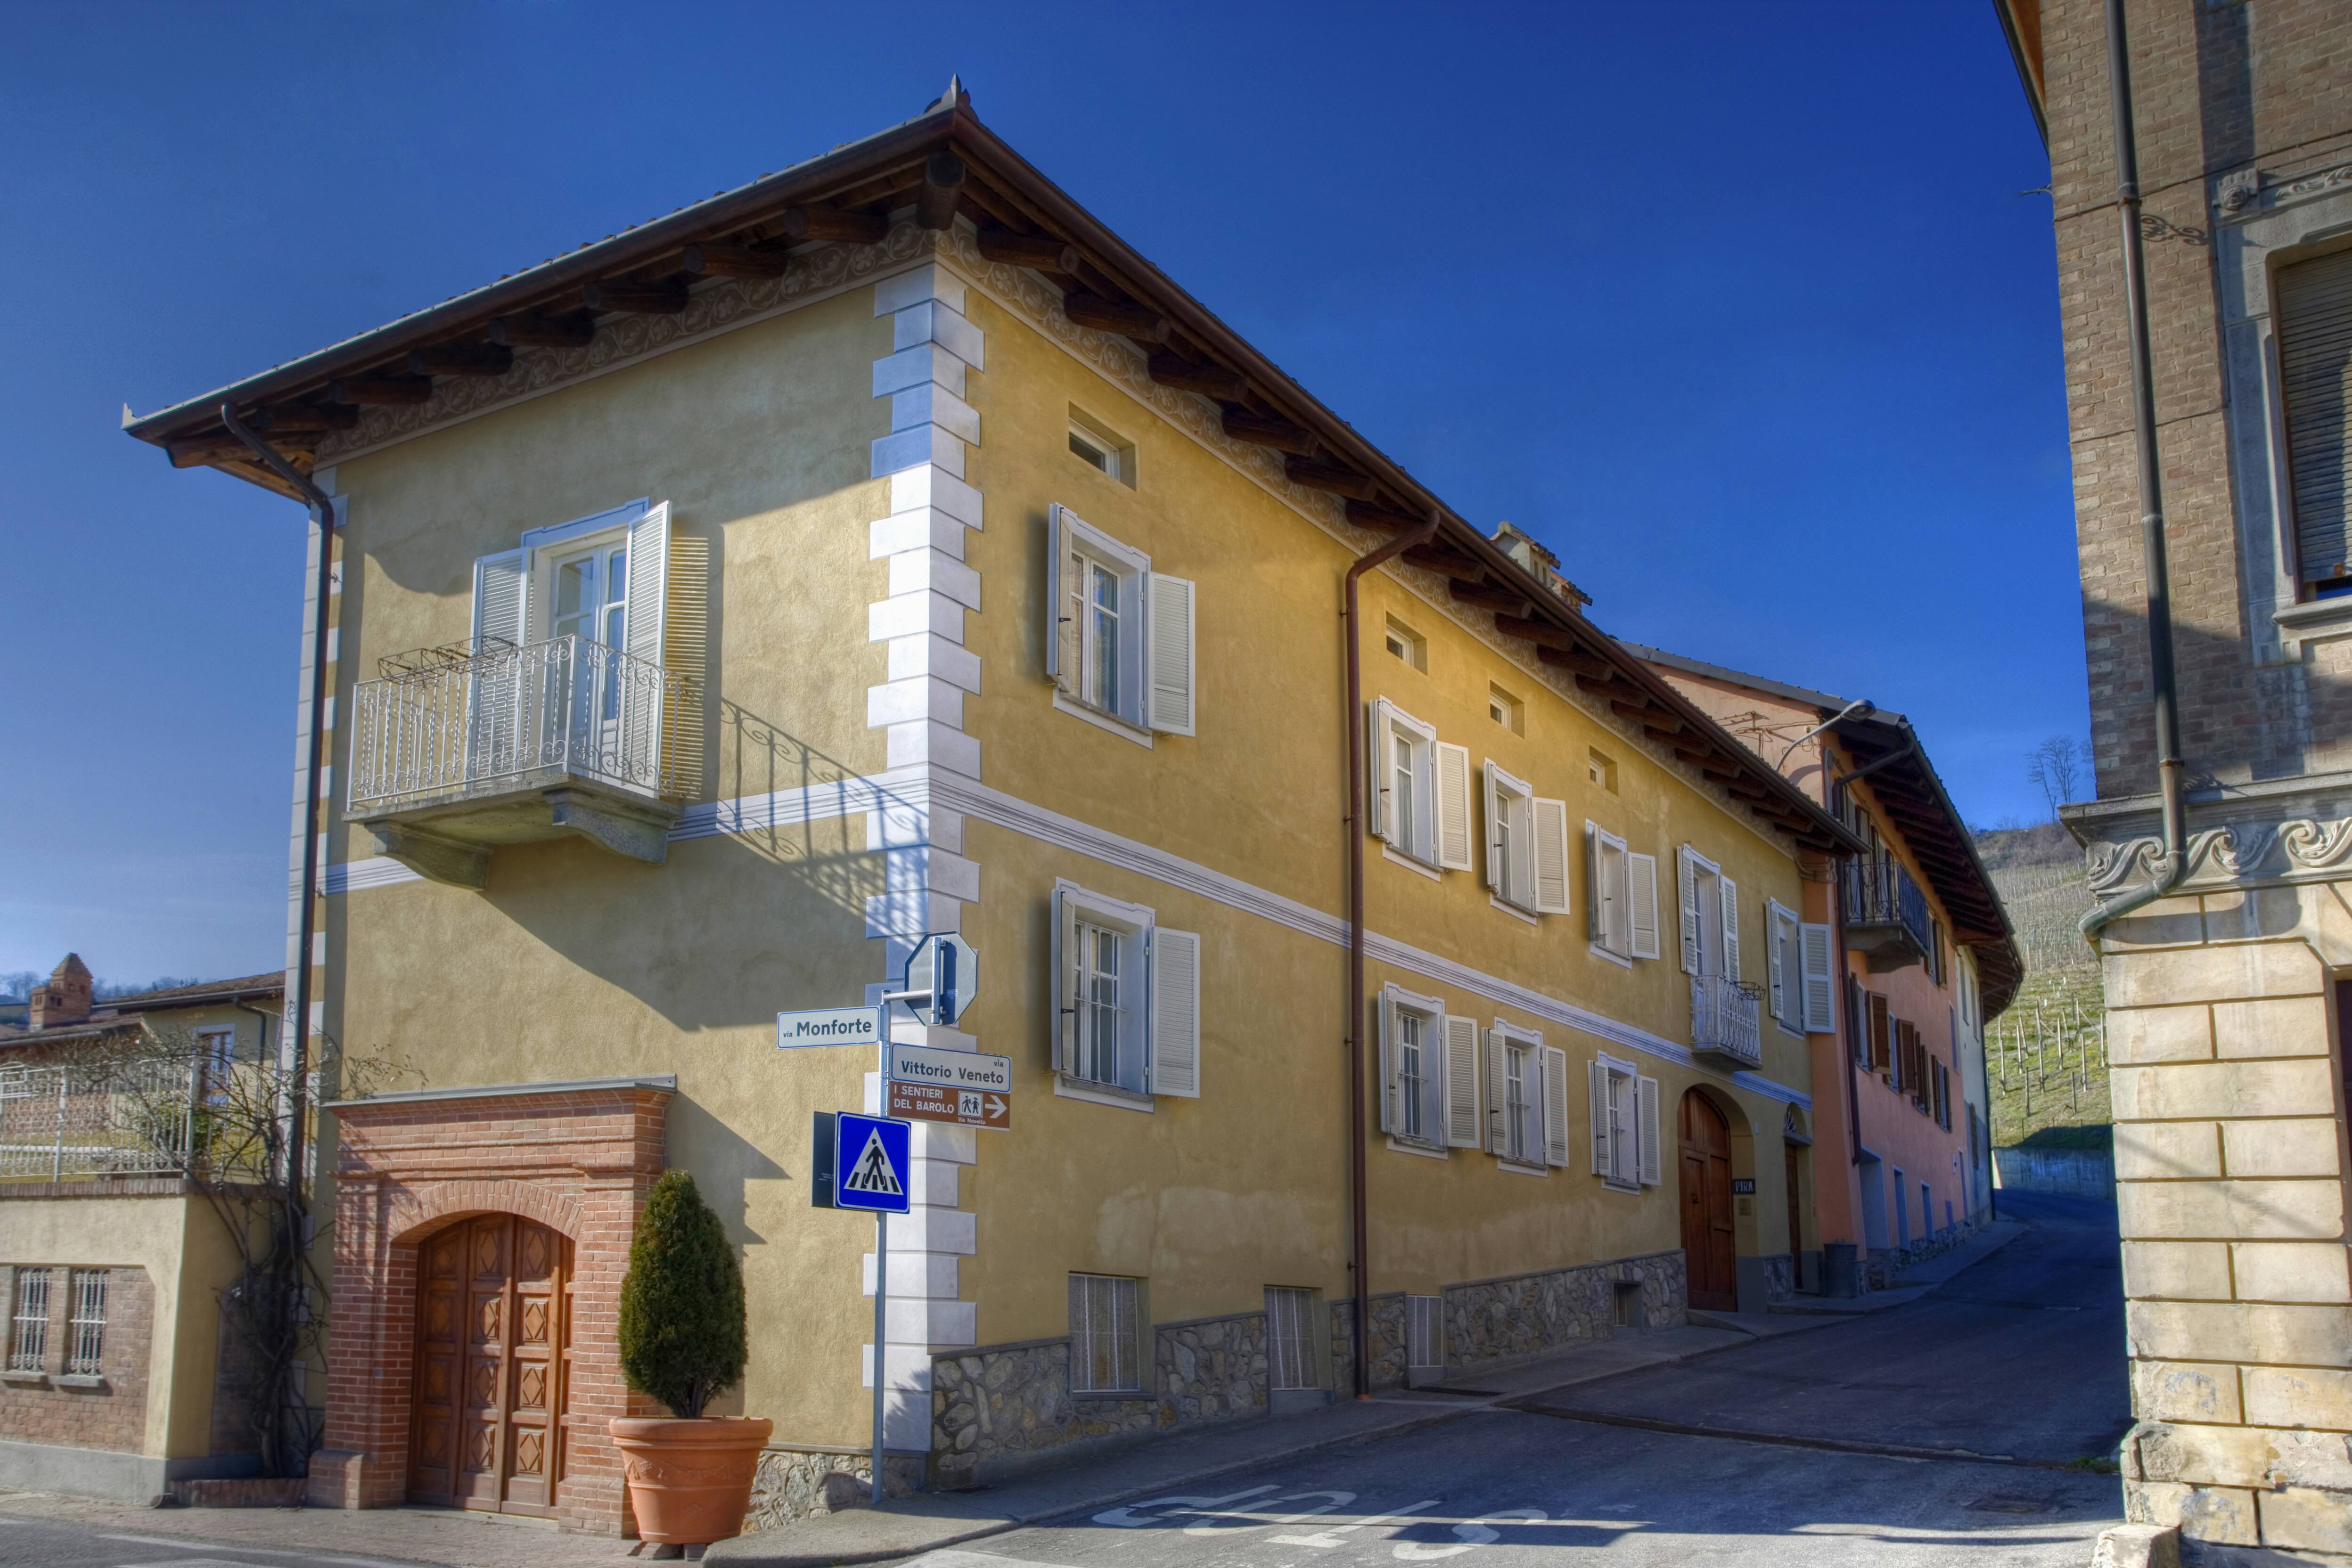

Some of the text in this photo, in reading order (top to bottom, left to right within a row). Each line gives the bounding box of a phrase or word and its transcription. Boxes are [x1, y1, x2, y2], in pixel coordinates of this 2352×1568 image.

[797, 1018, 872, 1037] Monforte
[993, 1059, 1003, 1067] via
[901, 1060, 1004, 1084] Vittorio Veneto
[894, 1084, 943, 1099] I SENTIERI
[894, 1098, 954, 1114] DEL BAROLO
[1735, 1181, 1754, 1192] PIRA
[1091, 1484, 1549, 1560] STOP
